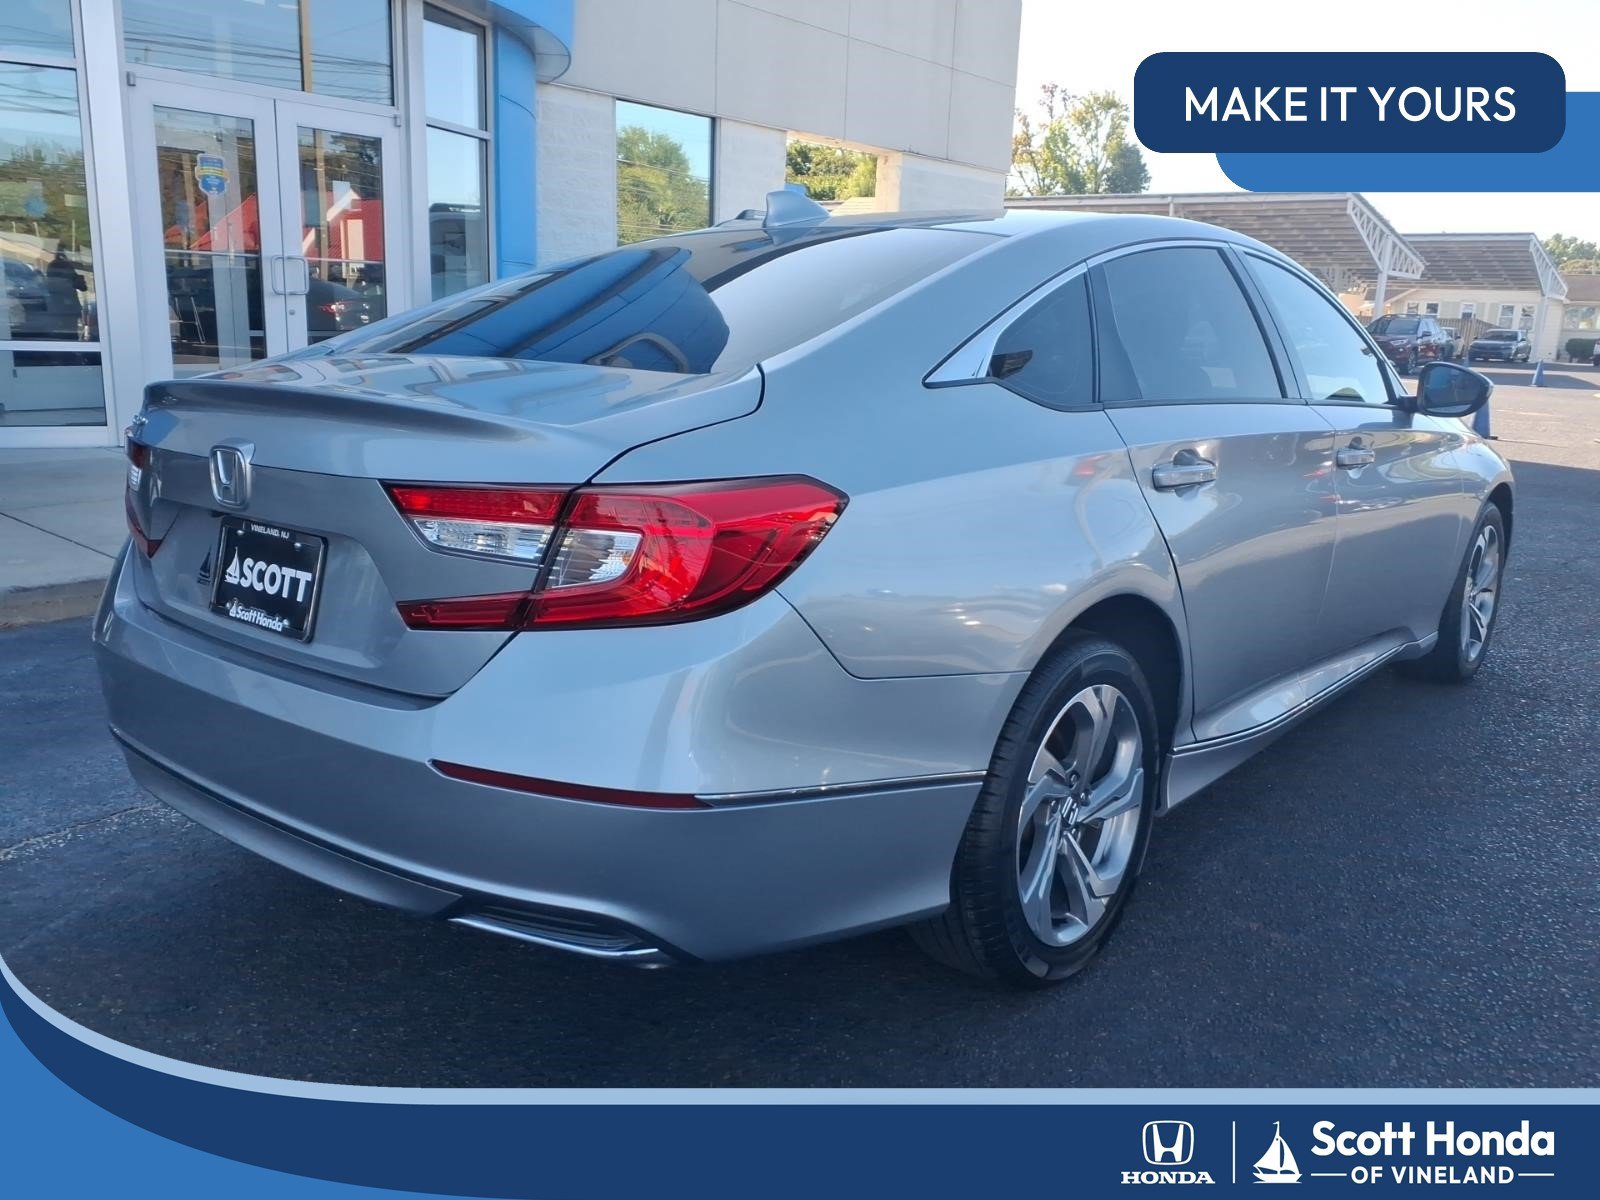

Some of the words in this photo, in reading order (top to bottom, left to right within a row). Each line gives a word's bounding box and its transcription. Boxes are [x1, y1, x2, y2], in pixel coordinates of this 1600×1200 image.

[280, 530, 290, 540] NJ
[240, 557, 312, 603] SCOTT
[236, 605, 257, 623] Scott
[255, 611, 283, 632] Honda
